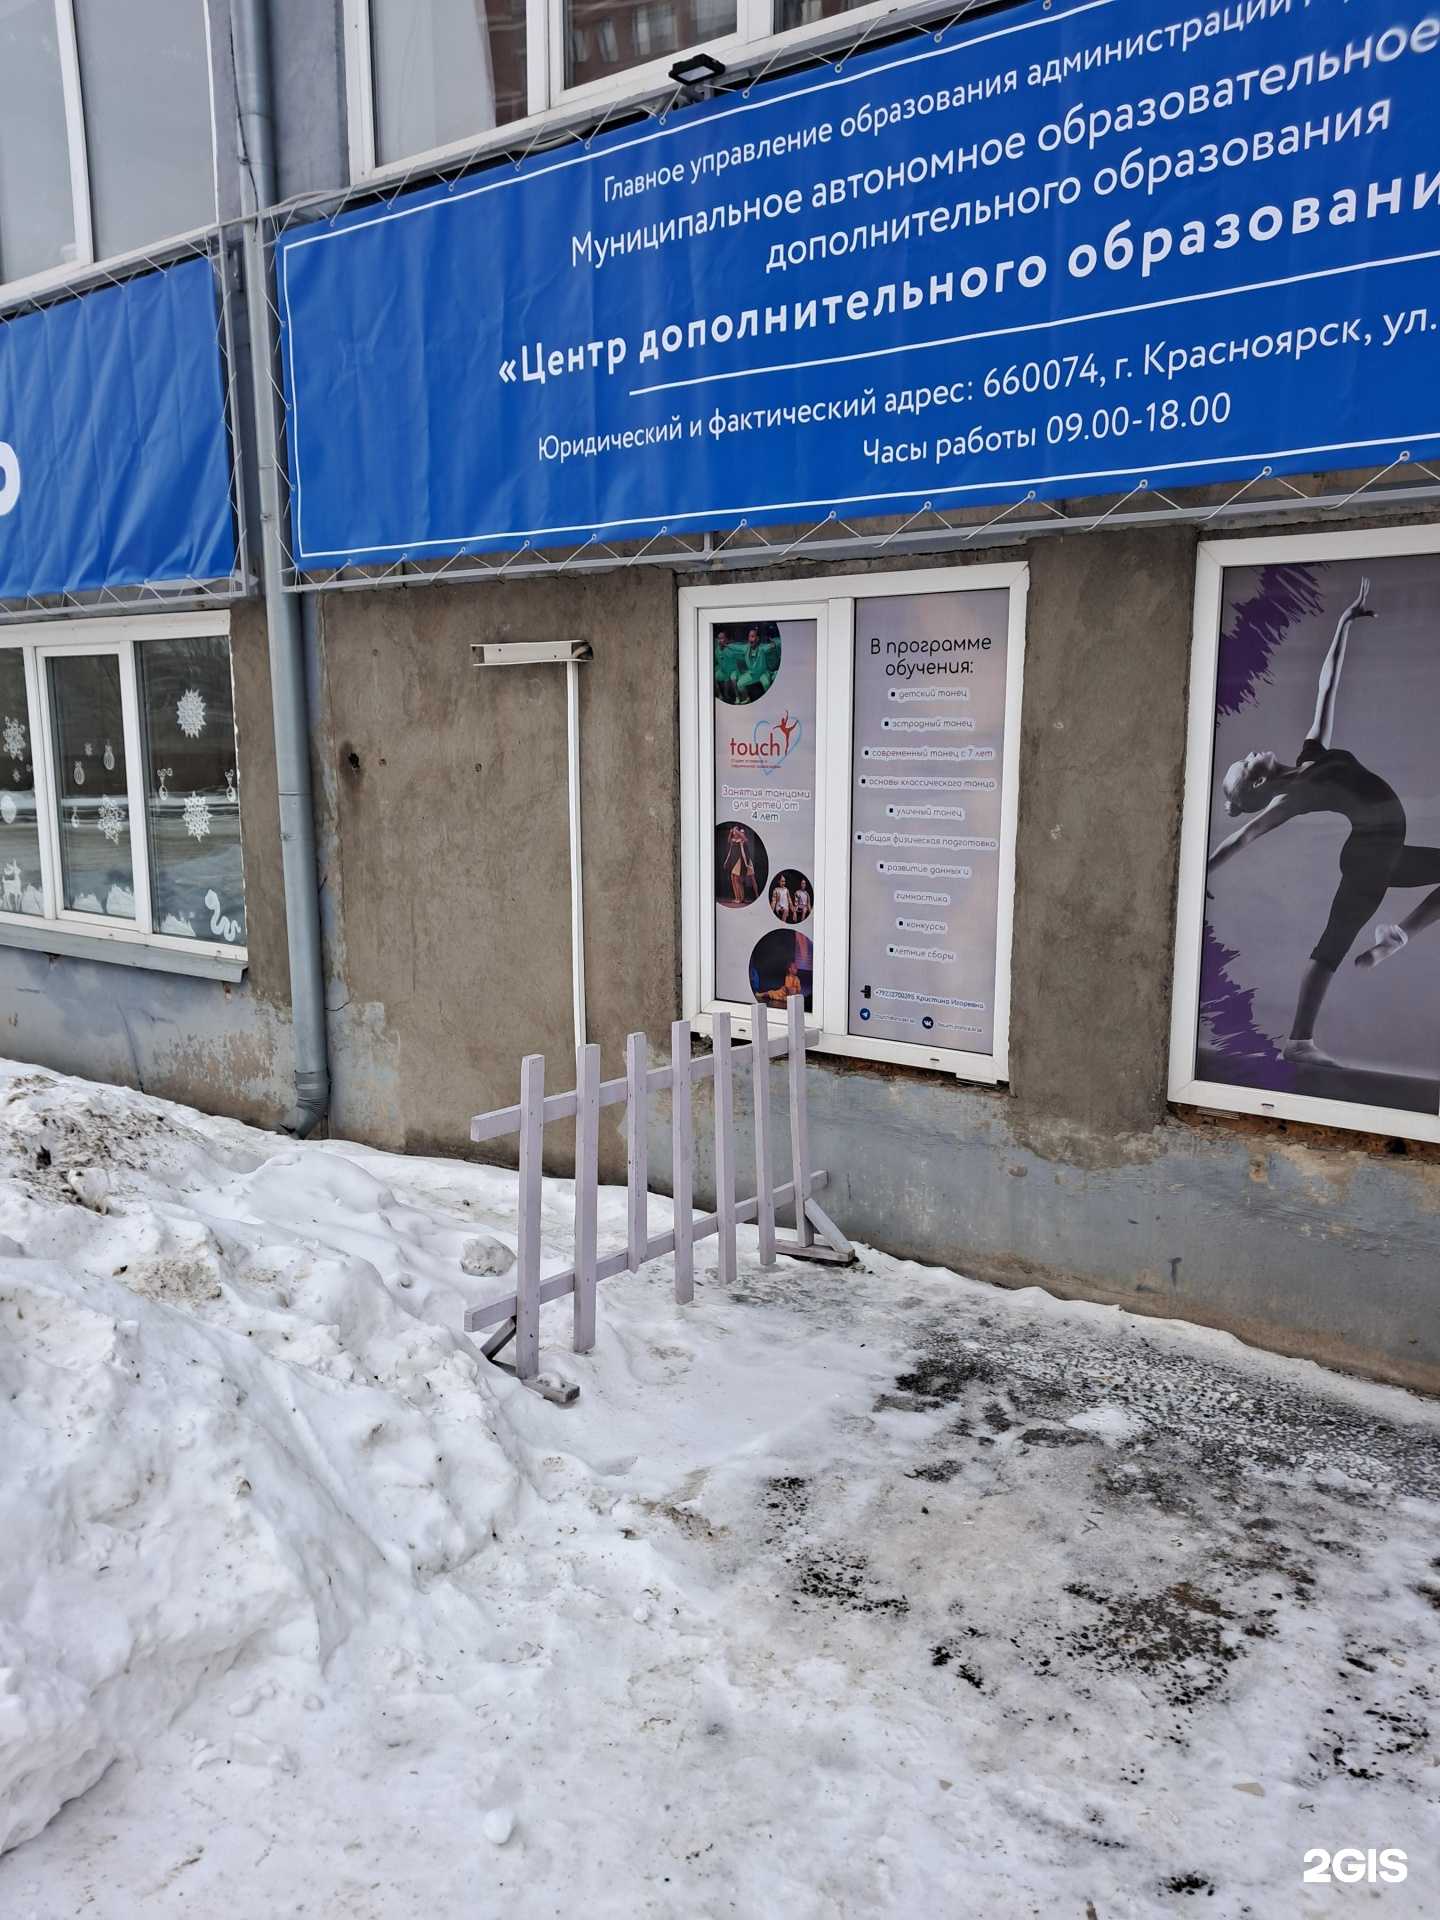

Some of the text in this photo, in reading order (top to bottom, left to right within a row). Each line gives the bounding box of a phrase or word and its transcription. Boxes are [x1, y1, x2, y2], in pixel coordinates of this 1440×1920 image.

[604, 163, 685, 202] Главное
[690, 123, 833, 184] управление
[840, 70, 1017, 136] образования
[572, 18, 1440, 268] Муниципальное автономное образовательное
[765, 99, 1390, 274] дополнительного образования
[499, 338, 627, 385] «Центр
[639, 255, 1047, 363] дополнительного
[538, 308, 1437, 463] Юридический и фактический адрес: 660074, г. Красноярск, ул.
[863, 392, 1231, 465] Часы работы 09.00-18.00
[870, 637, 992, 657] В программе
[885, 658, 974, 679] обучения:
[898, 688, 968, 700] детский танец
[892, 718, 973, 730] эстрадный танец
[730, 732, 780, 756] touch
[872, 748, 928, 760] современный
[930, 750, 959, 760] танец
[974, 750, 993, 758] лет
[868, 778, 995, 790] основы классического танца
[722, 786, 810, 799] Занятия танцами
[733, 801, 749, 810] для
[751, 801, 782, 811] детей
[896, 807, 962, 818] уличный танец
[752, 811, 779, 821] 4 лет
[864, 834, 996, 849] общая физическая подготовка
[887, 863, 928, 874] развитие
[930, 866, 961, 877] данных
[896, 893, 948, 903] гимнастика
[906, 922, 946, 932] конкурсы
[895, 949, 954, 961] летние сборы
